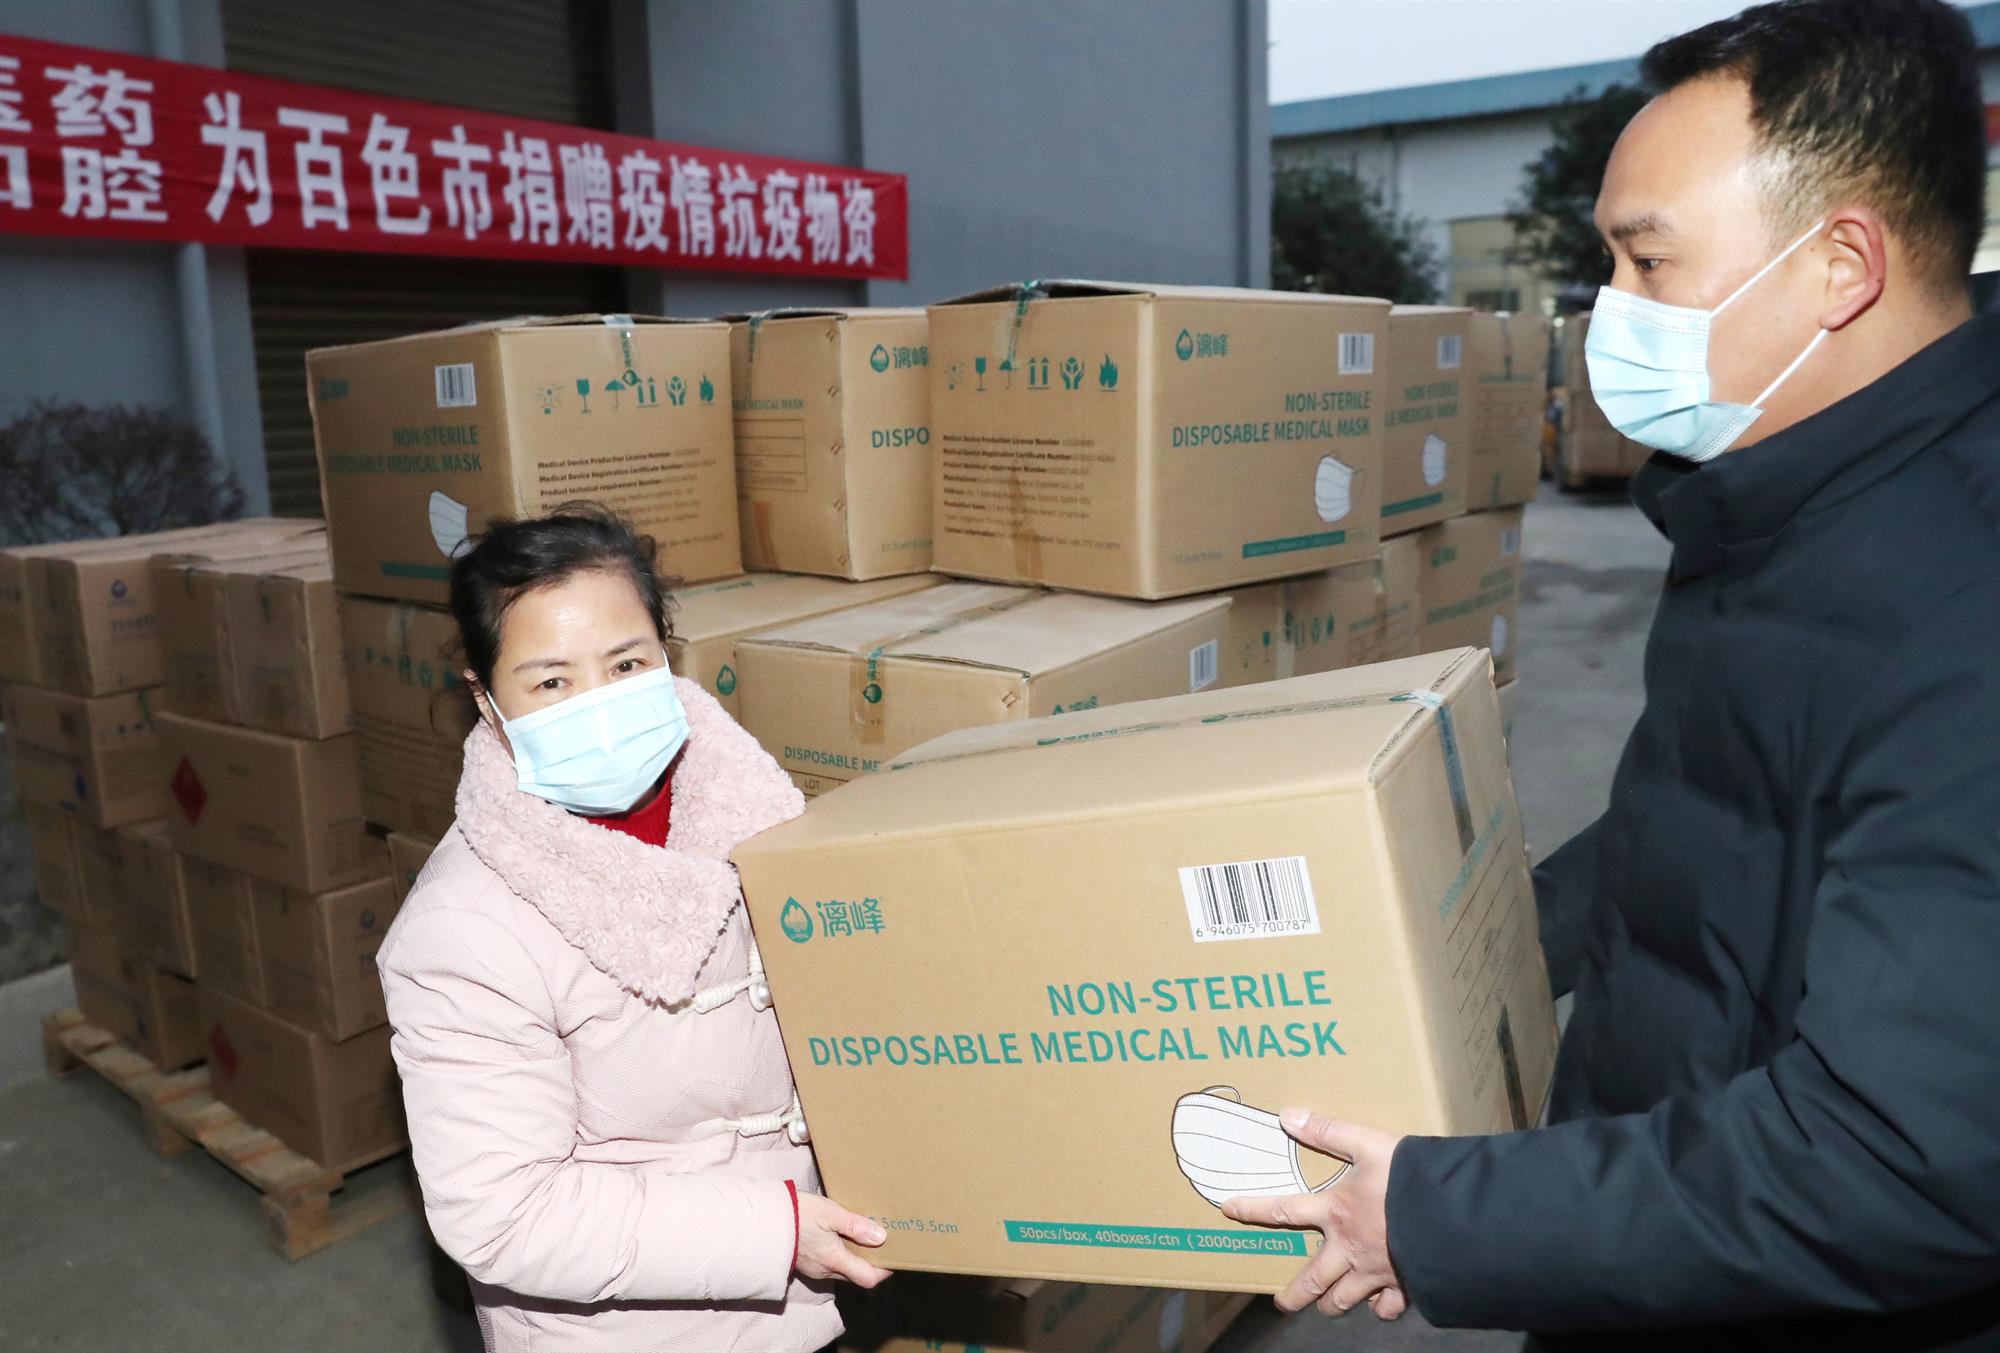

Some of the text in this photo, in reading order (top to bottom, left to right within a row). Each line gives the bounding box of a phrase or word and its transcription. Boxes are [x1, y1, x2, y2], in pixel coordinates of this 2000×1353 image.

[201, 91, 877, 267] 为百色市捐赠疫情抗疫物资
[1285, 391, 1371, 412] NON-STERILE
[1172, 416, 1371, 448] DISPOSABLE MEDICAL MASK
[784, 746, 858, 770] DISPOSABLE
[815, 897, 885, 938] 漓峰
[1196, 919, 1307, 938] 6 946075 700787
[1046, 969, 1332, 1018] NON-STERILE
[808, 1020, 1347, 1068] DISPOSABLE MEDICAL MASK
[1018, 1226, 1093, 1243] 50pcs/box,
[1095, 1230, 1180, 1246] 40boxes/ctn
